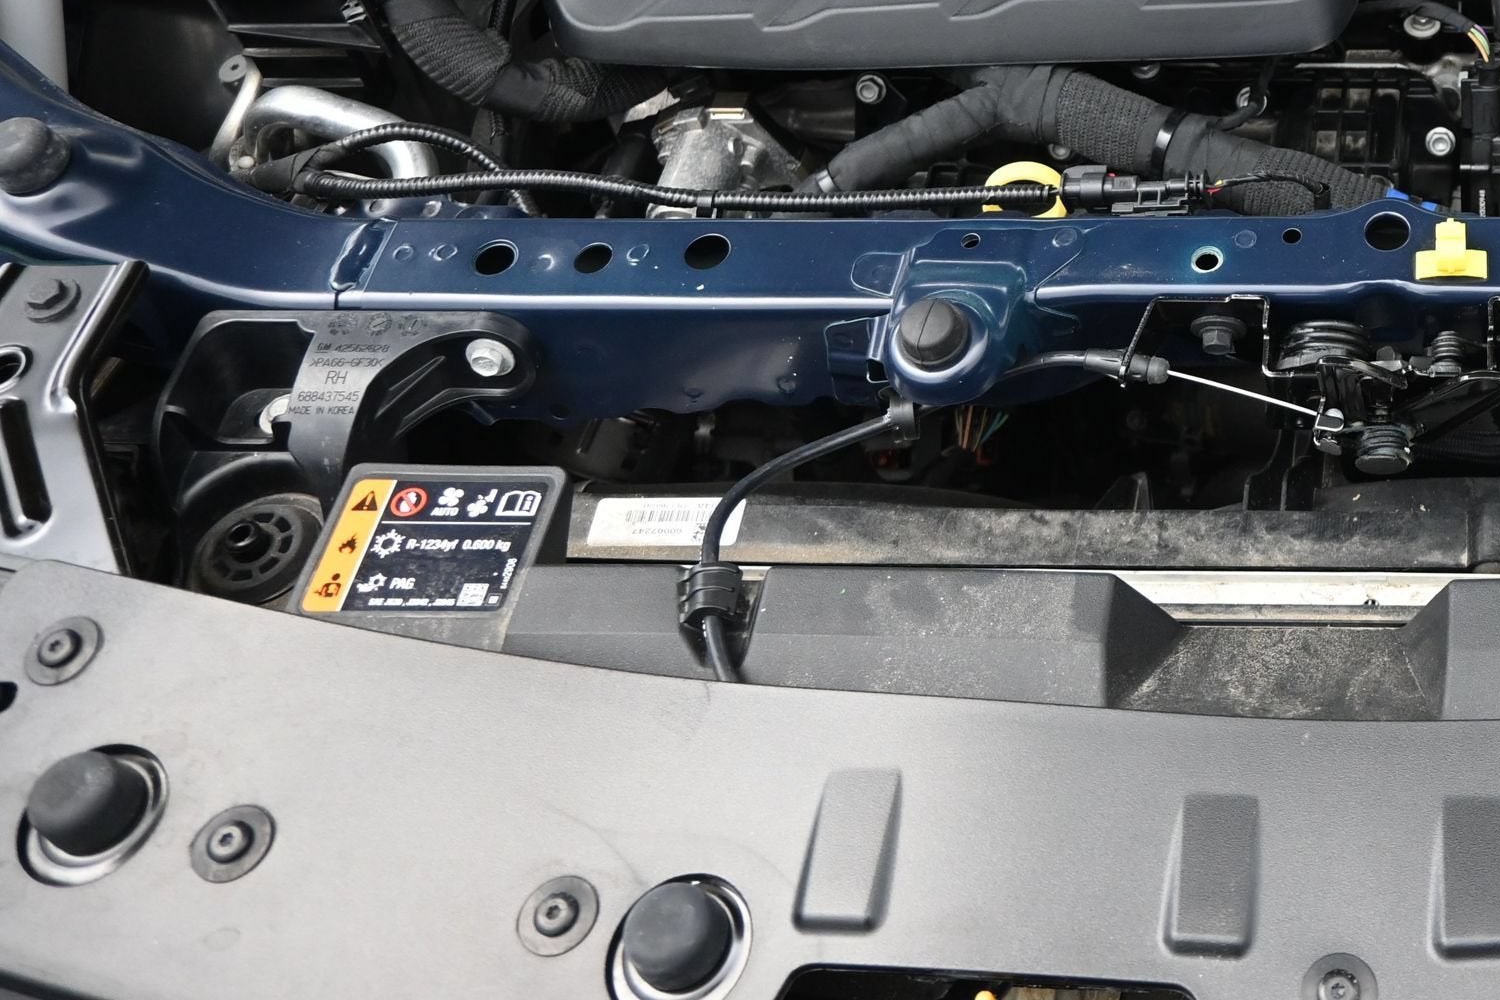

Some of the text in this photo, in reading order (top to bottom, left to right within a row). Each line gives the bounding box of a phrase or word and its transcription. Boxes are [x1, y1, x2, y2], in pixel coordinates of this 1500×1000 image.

[324, 370, 349, 385] RH
[297, 390, 361, 402] 688437545
[288, 405, 355, 415] MADE IN KOREA
[430, 506, 459, 517] AUTO
[405, 538, 512, 554] R-1234yf 0.600 kg
[389, 577, 416, 590] PAG
